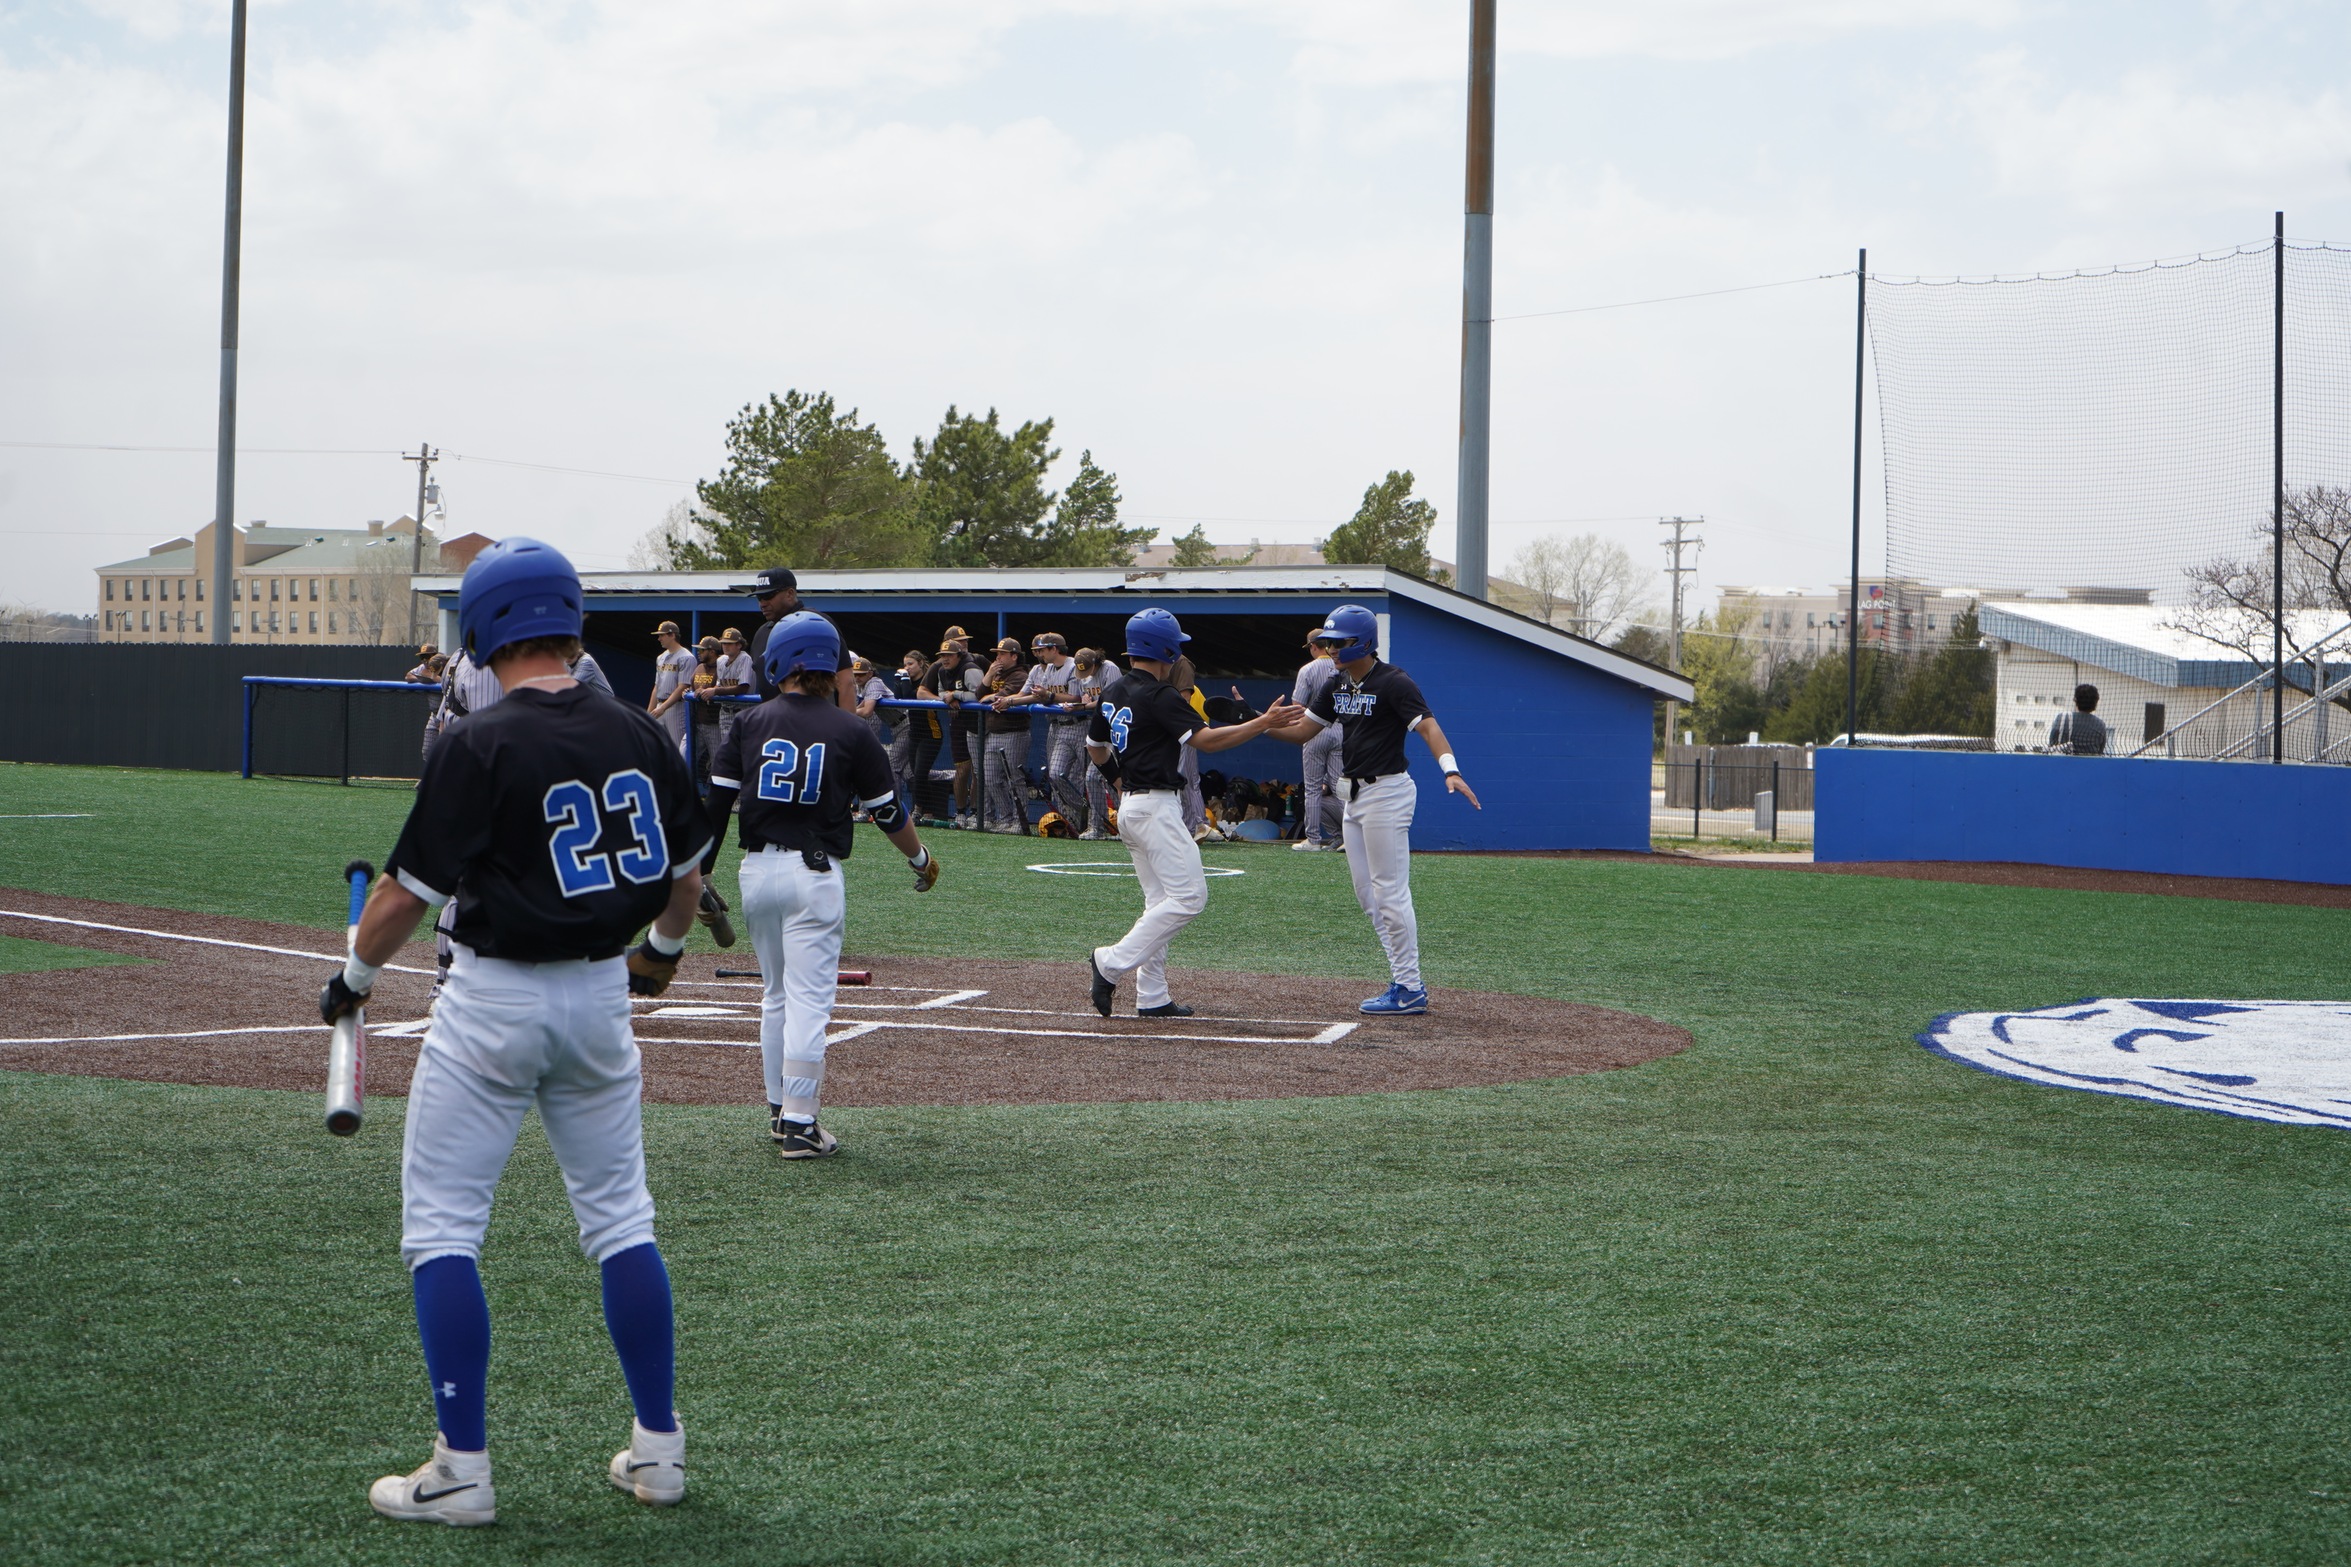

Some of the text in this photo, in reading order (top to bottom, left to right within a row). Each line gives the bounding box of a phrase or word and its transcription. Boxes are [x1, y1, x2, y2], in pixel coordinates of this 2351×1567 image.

[1332, 693, 1377, 716] PRATT
[758, 738, 826, 804] 21
[543, 768, 670, 898] 23
